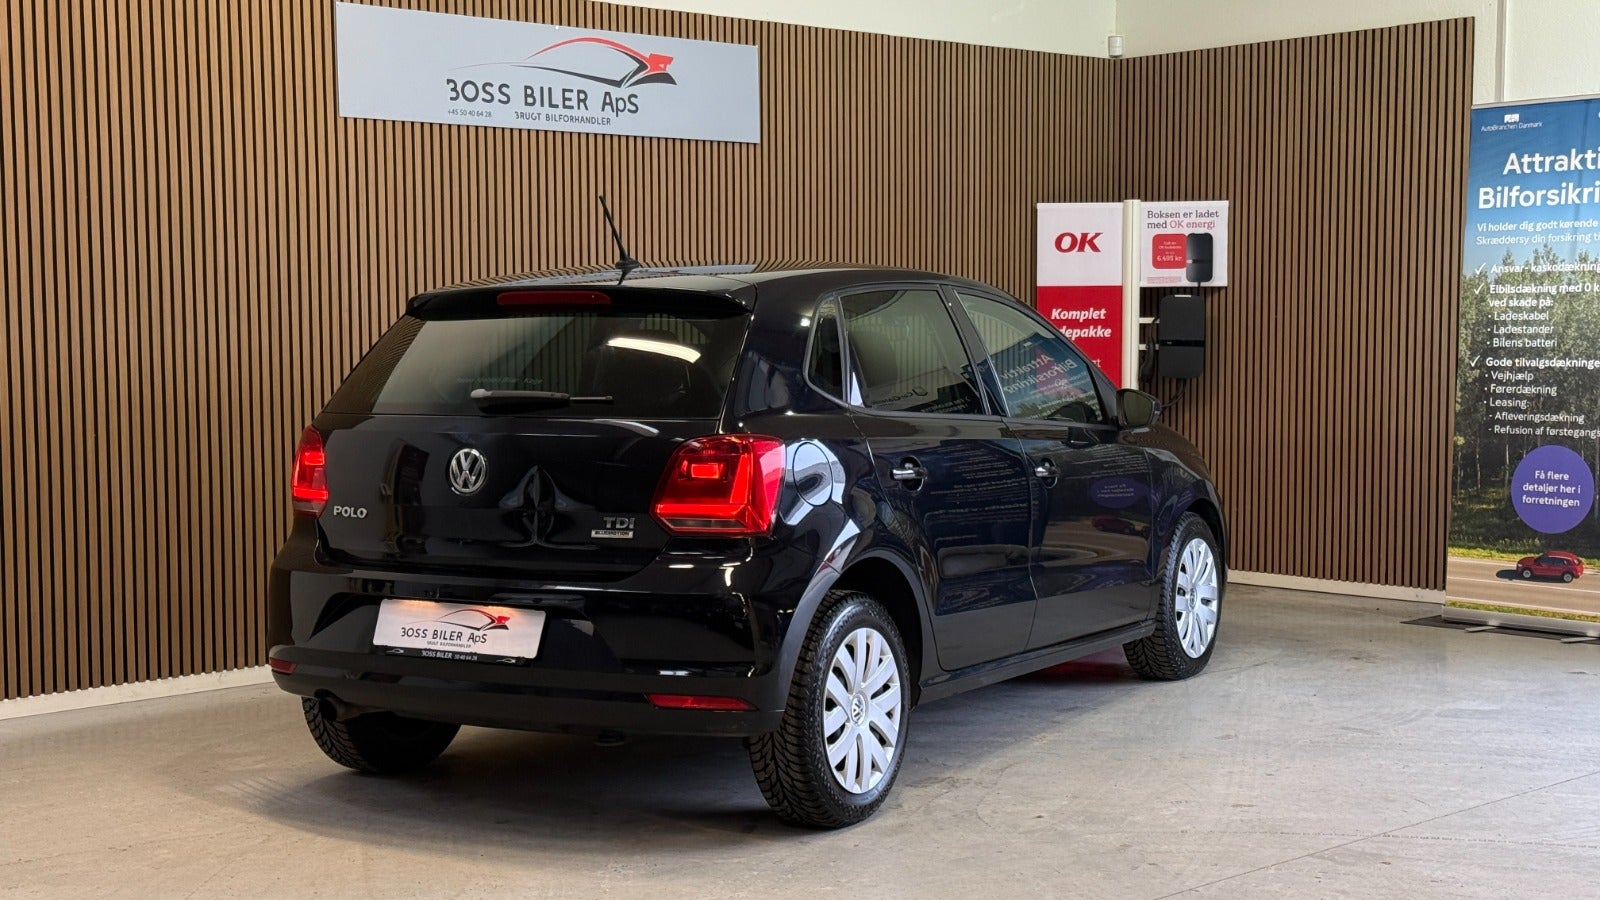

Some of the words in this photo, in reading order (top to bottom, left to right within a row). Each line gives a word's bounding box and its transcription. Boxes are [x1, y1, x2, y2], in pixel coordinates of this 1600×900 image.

[524, 85, 588, 110] BILER
[601, 92, 639, 117] ApS
[545, 113, 611, 125] BILFORHANDLER
[1518, 121, 1543, 129] Danmark
[1478, 180, 1600, 209] Bilforsikri
[1147, 210, 1180, 218] Boksen
[1195, 210, 1220, 218] ladet
[1147, 220, 1167, 229] med
[1170, 220, 1184, 228] OK
[1186, 220, 1216, 230] energi
[1477, 222, 1486, 232] Vi
[1488, 222, 1518, 231] holder
[1519, 221, 1534, 232] dig
[1536, 220, 1557, 232] godt
[1559, 219, 1598, 229] kørende
[1054, 232, 1103, 253] OK
[1476, 235, 1529, 246] Skræddersy
[1532, 234, 1546, 243] din
[1548, 232, 1591, 243] forsikring
[1531, 261, 1600, 273] kaskodækning
[1490, 284, 1557, 294] Elbilsdækning
[1559, 283, 1582, 293] med
[1584, 282, 1591, 292] 0
[1489, 298, 1506, 307] ved
[1508, 298, 1537, 307] skade
[1539, 297, 1554, 309] på:
[1051, 308, 1106, 322] Komplet
[1494, 311, 1549, 320] Ladeskabel
[1059, 325, 1112, 340] depakke
[1494, 324, 1554, 334] Ladestander
[1493, 338, 1523, 347] Bilens
[1525, 338, 1558, 347] batteri
[1486, 357, 1512, 367] Gode
[1515, 357, 1600, 370] tilvalgsdækninge
[1490, 370, 1534, 382] Vejhjælp
[1490, 384, 1558, 396] Førerdækning
[1494, 412, 1584, 424] Afleveringsdækning
[1494, 425, 1533, 435] Refusion
[1535, 426, 1544, 435] af
[1546, 427, 1600, 439] førstegangs
[1535, 470, 1545, 479] Få
[1547, 471, 1569, 480] flere
[1522, 483, 1558, 494] detaljer
[1560, 484, 1576, 494] her
[1522, 495, 1580, 508] forretningen
[334, 506, 367, 519] POLO
[603, 517, 635, 529] TDI
[432, 630, 463, 641] BILER
[467, 632, 488, 644] ApS
[436, 651, 453, 659] BILER
